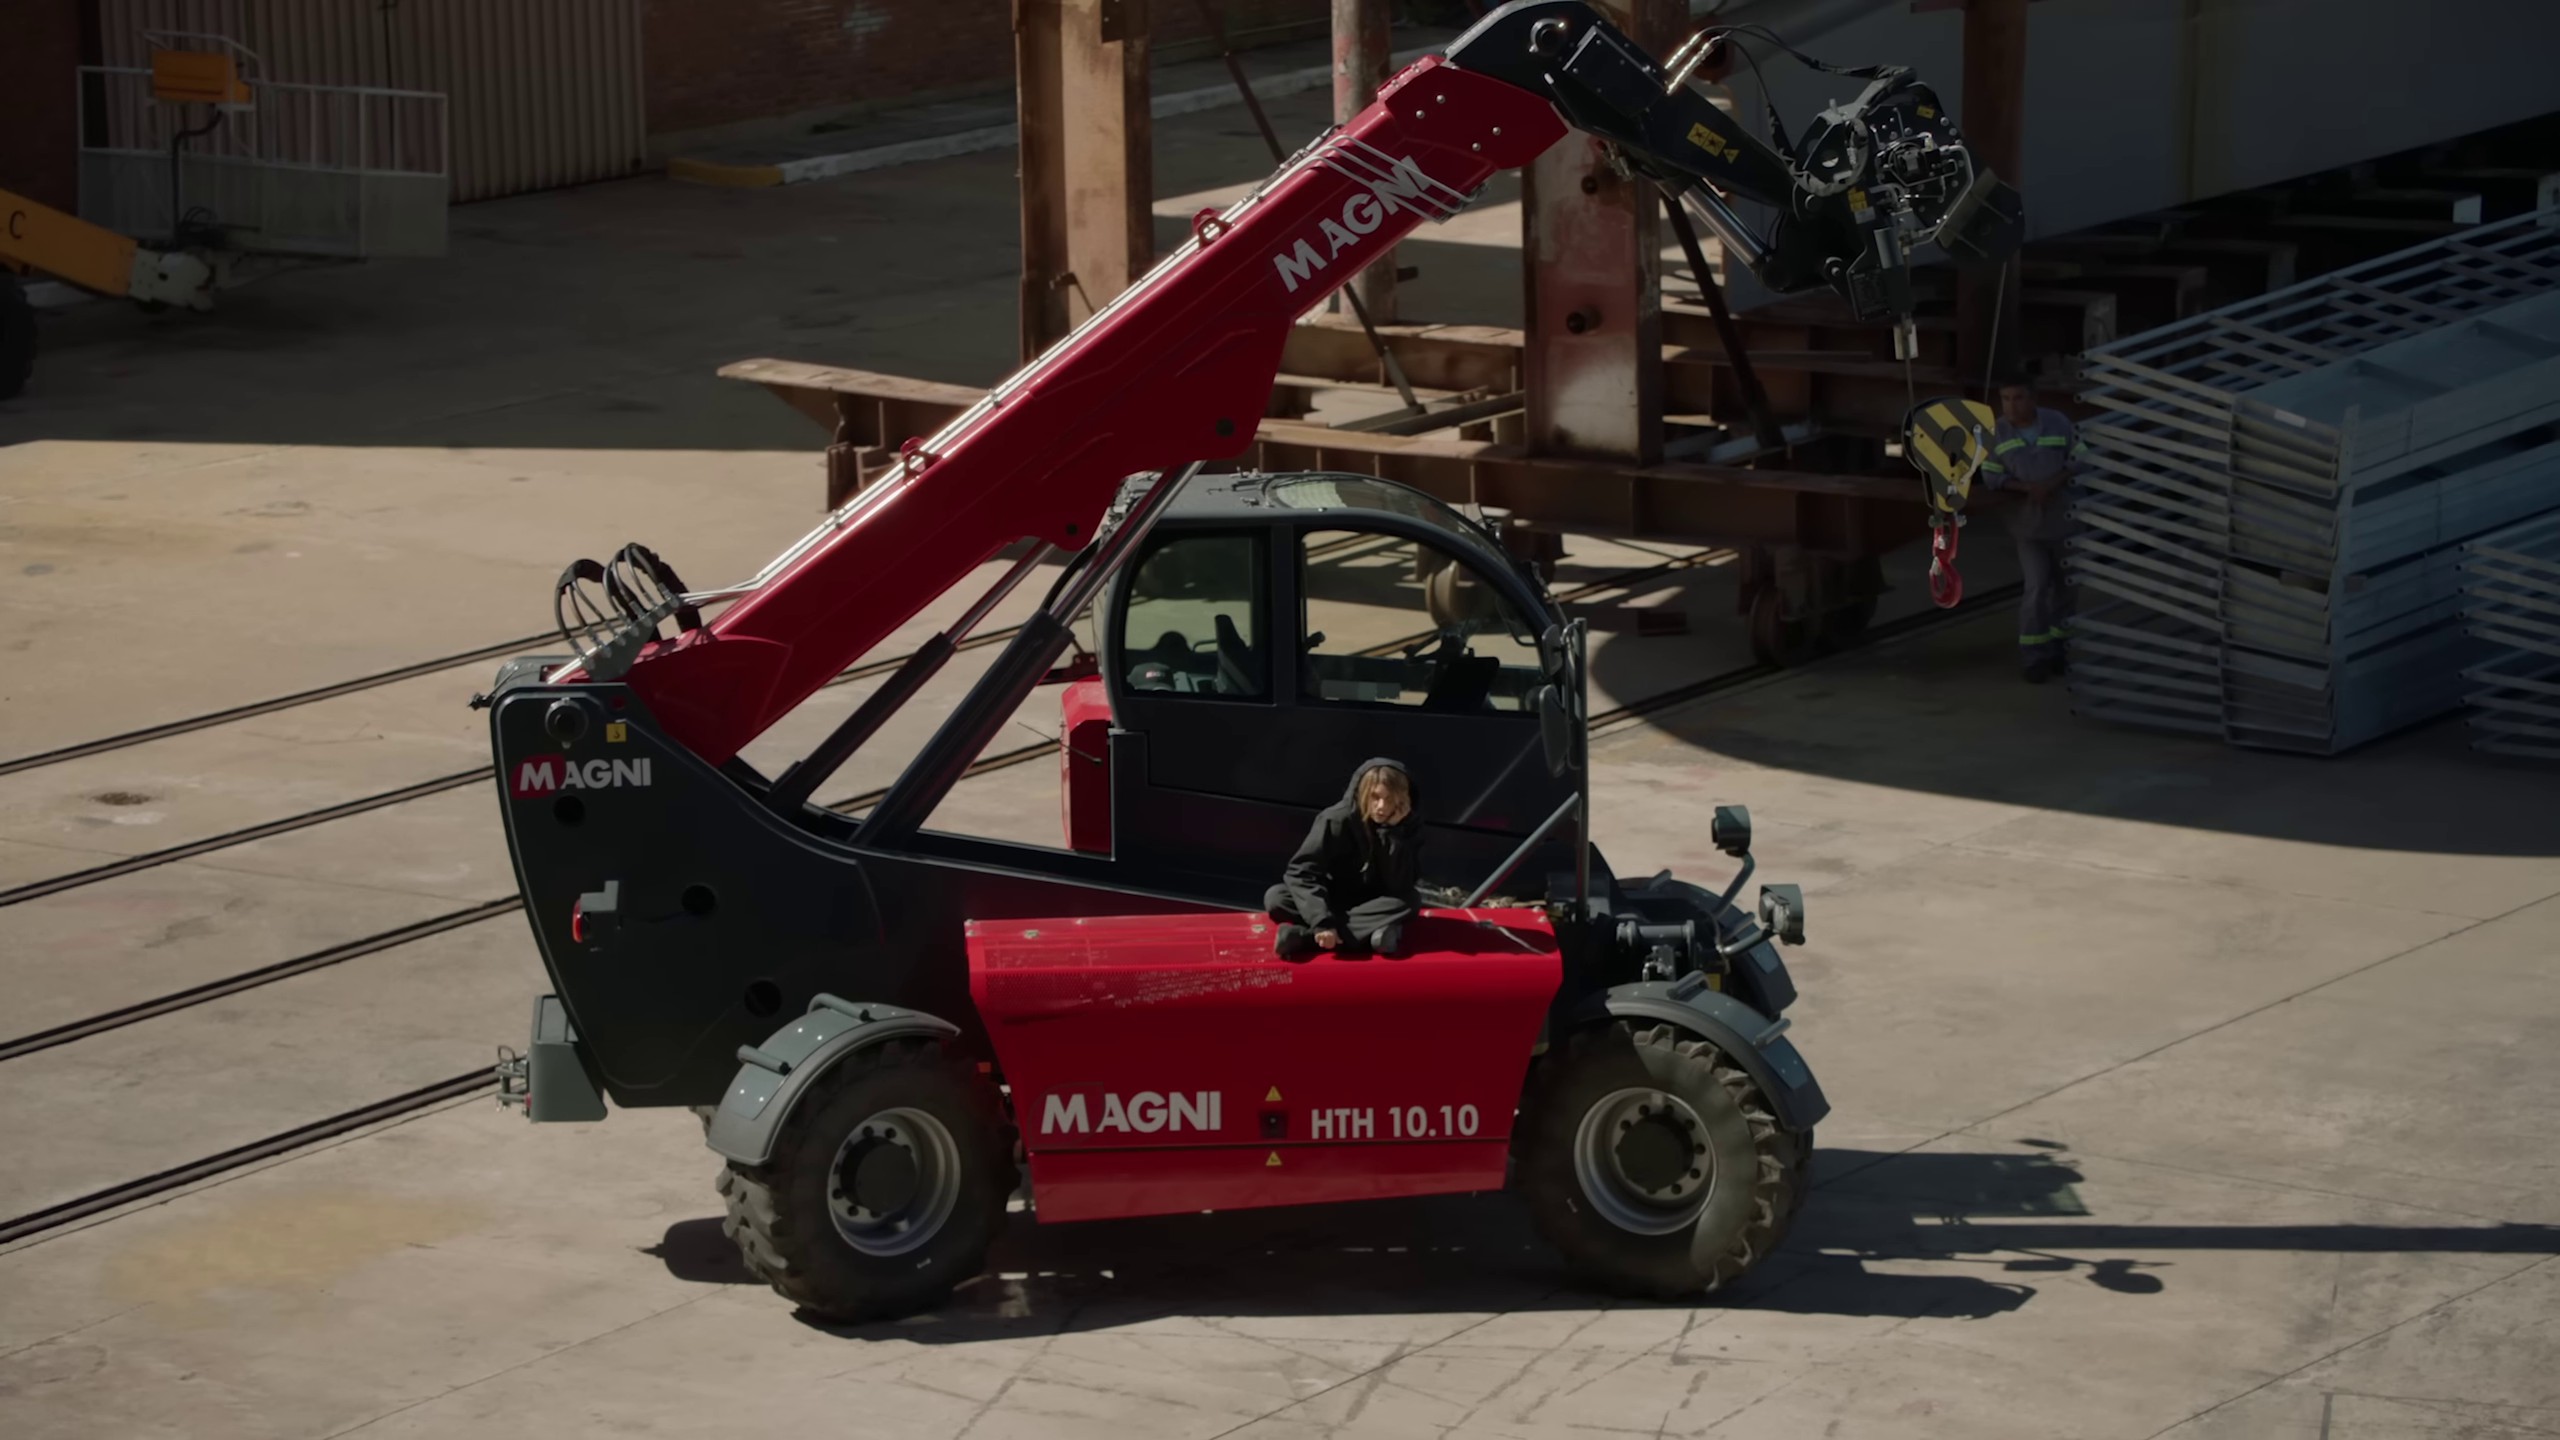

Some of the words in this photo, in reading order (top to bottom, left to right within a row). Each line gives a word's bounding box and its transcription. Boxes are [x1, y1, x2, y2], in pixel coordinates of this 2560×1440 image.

[1272, 154, 1434, 294] MAGNI
[519, 757, 652, 792] MAGNI
[1040, 1090, 1222, 1135] MAGNI
[1310, 1107, 1376, 1140] HTH
[1387, 1103, 1480, 1139] 10.10
